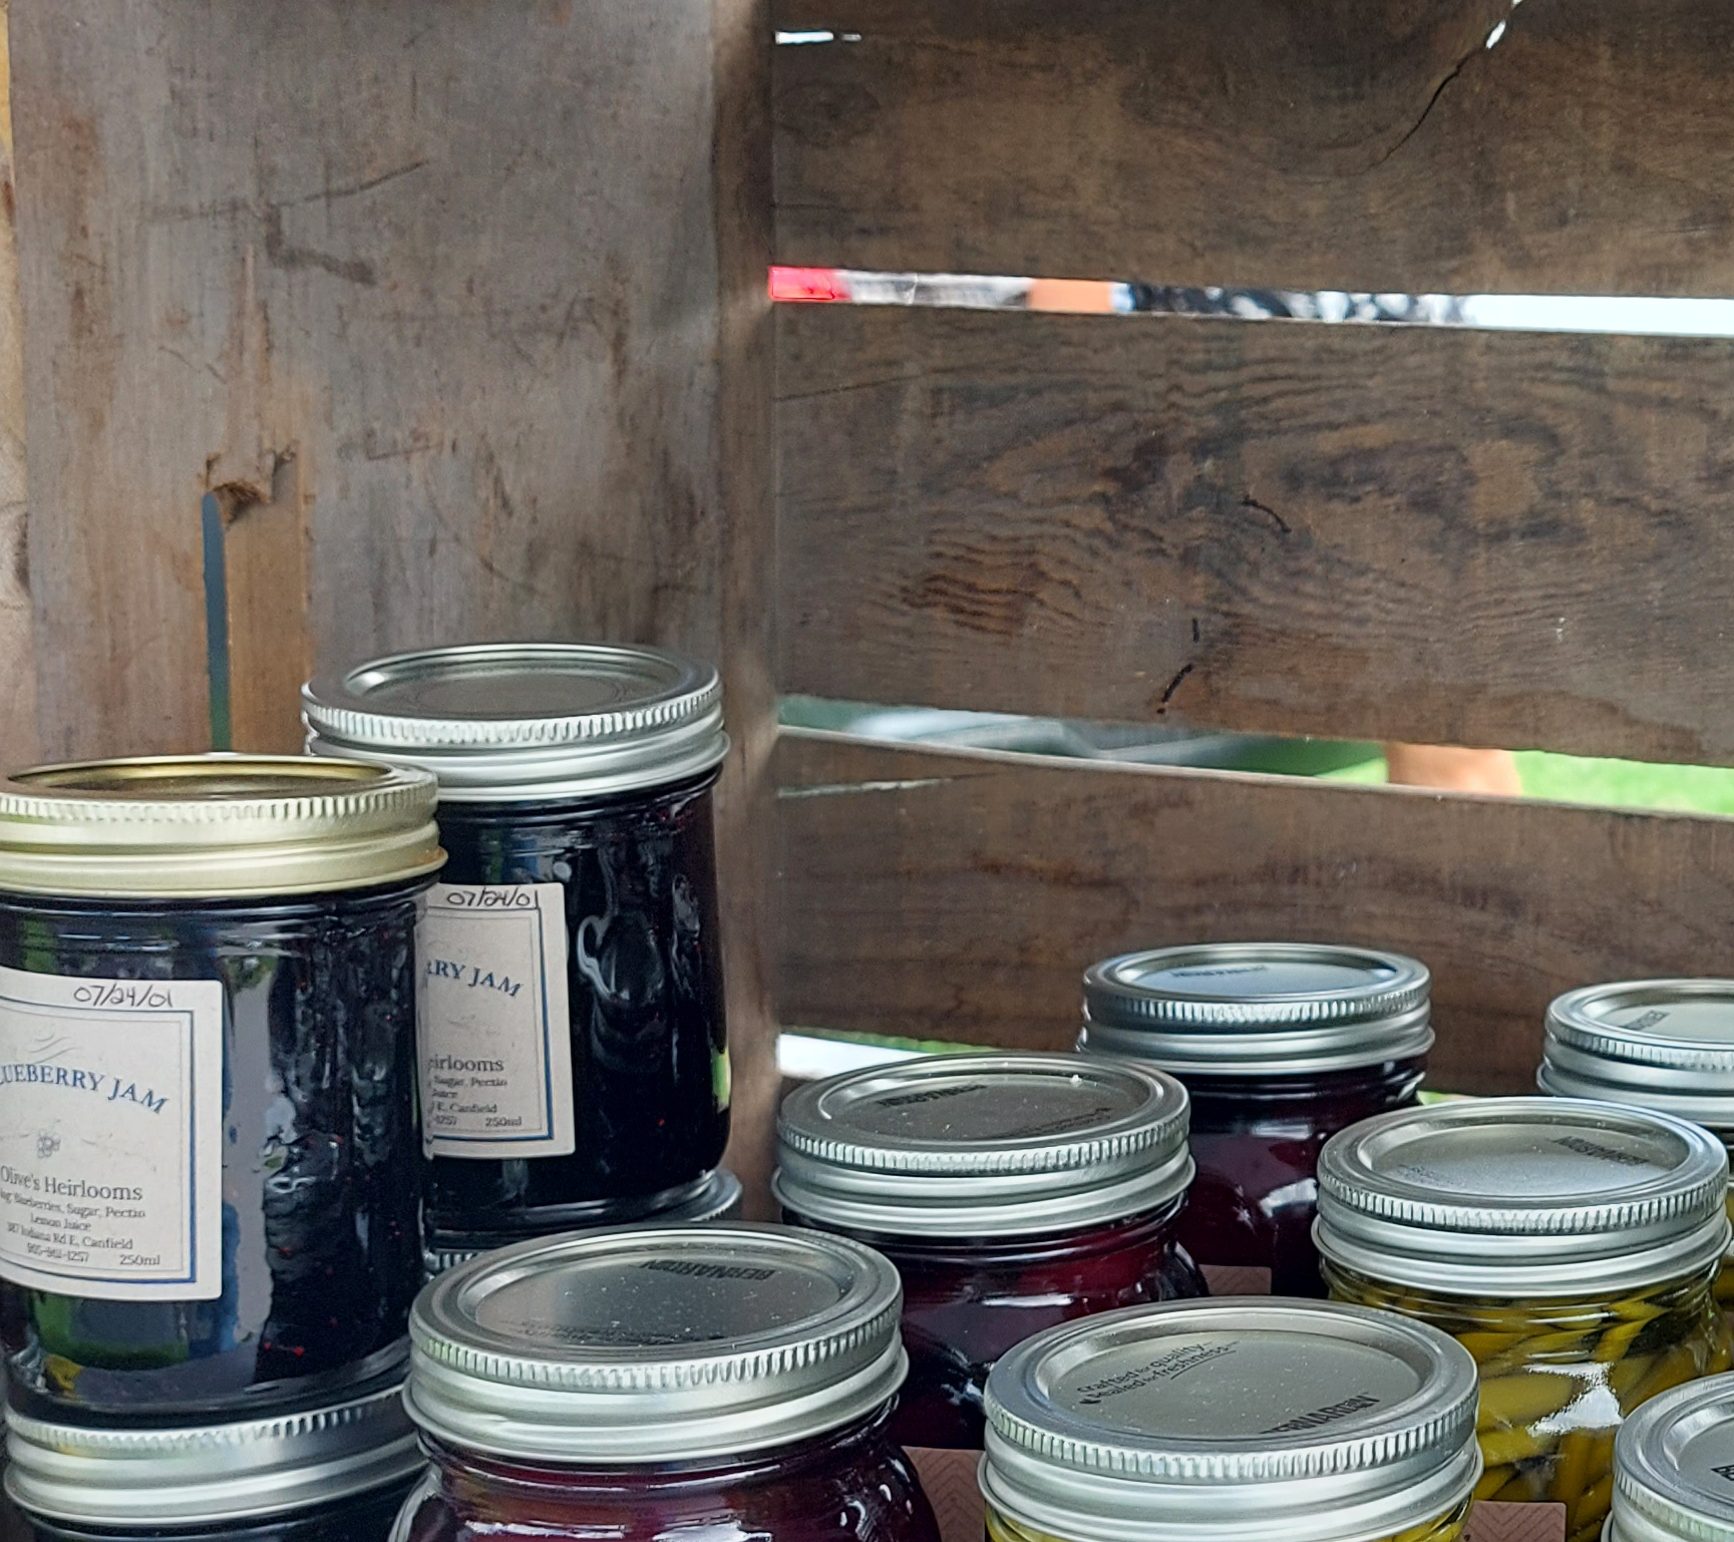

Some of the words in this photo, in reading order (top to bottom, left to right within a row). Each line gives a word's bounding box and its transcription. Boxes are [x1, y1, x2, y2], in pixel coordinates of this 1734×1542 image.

[447, 889, 538, 908] 07/24/01
[470, 967, 524, 998] JAM
[74, 983, 172, 1008] 07/24/01
[107, 1078, 169, 1114] JAM
[45, 1176, 143, 1200] Heirlooms
